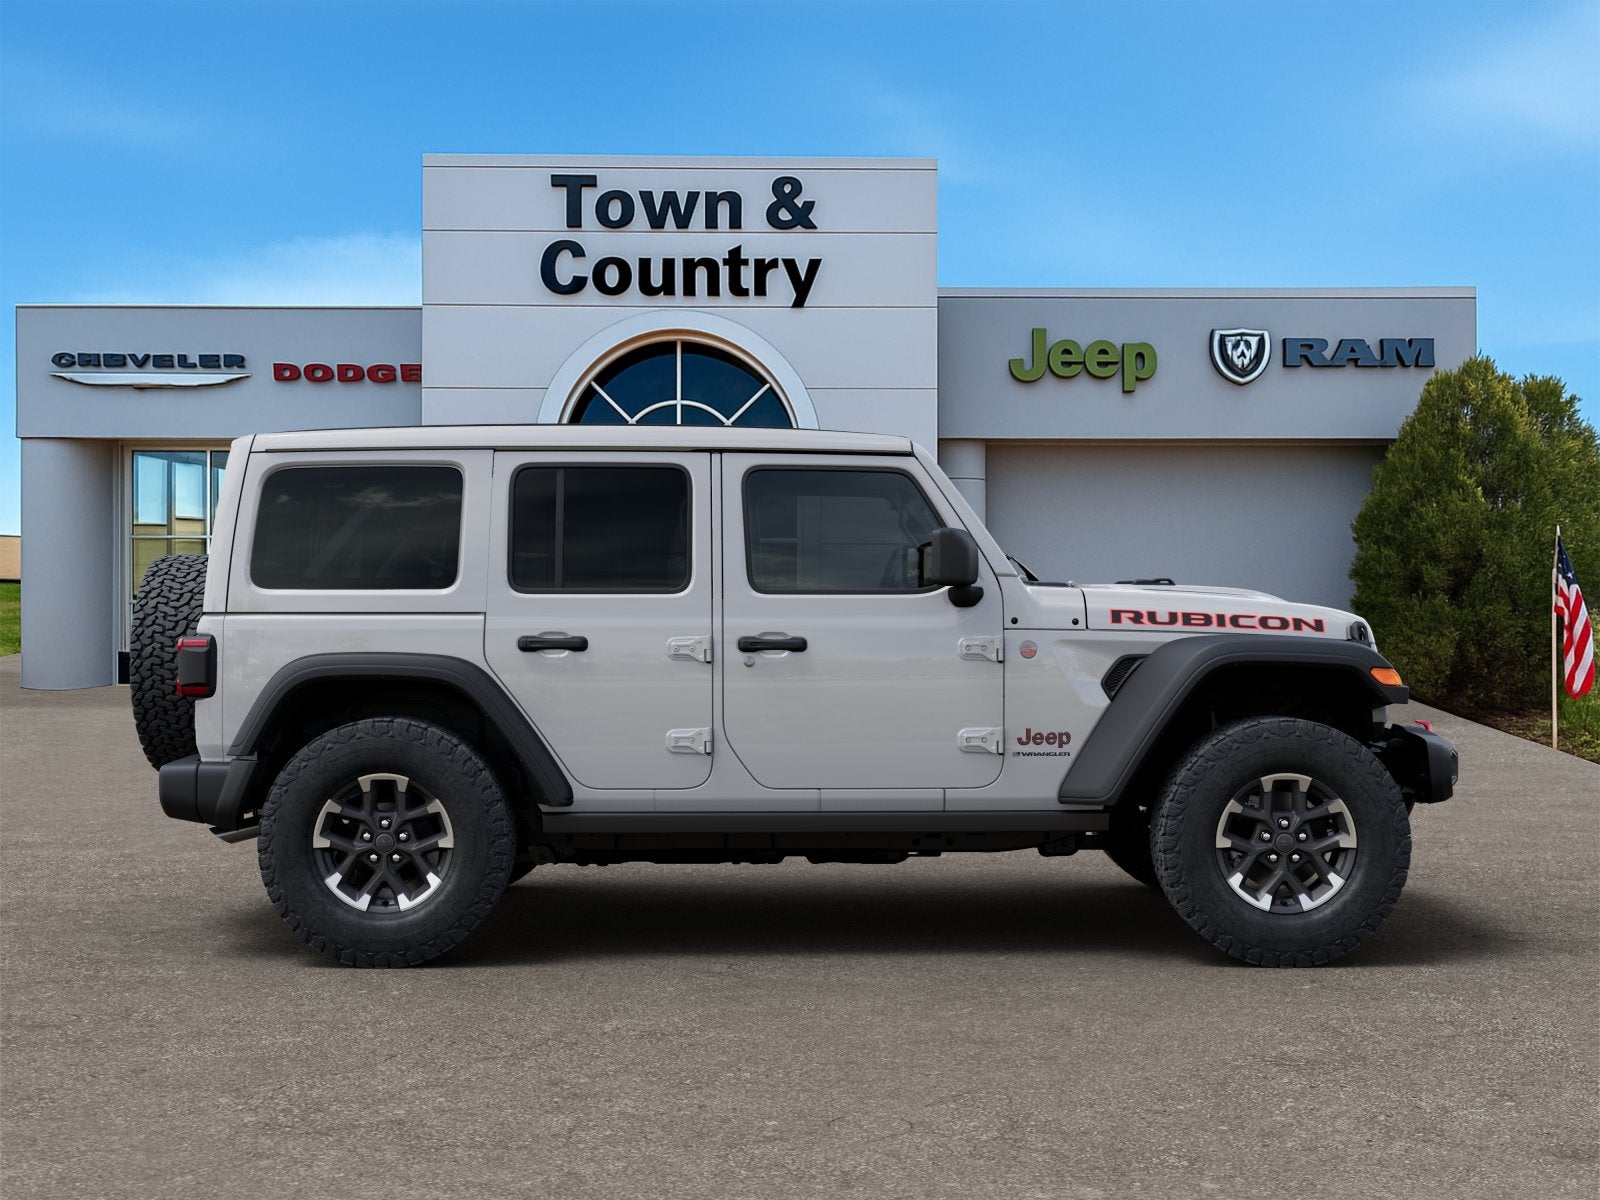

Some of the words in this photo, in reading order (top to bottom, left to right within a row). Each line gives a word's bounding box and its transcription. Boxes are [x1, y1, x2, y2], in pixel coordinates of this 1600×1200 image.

[551, 174, 742, 229] Town
[766, 176, 818, 230] &
[540, 239, 822, 308] Country
[1009, 328, 1157, 392] Jeep
[1282, 338, 1435, 367] RAM
[273, 363, 422, 382] DODGE
[1110, 609, 1325, 633] RUBICON
[1017, 728, 1071, 748] Jeep
